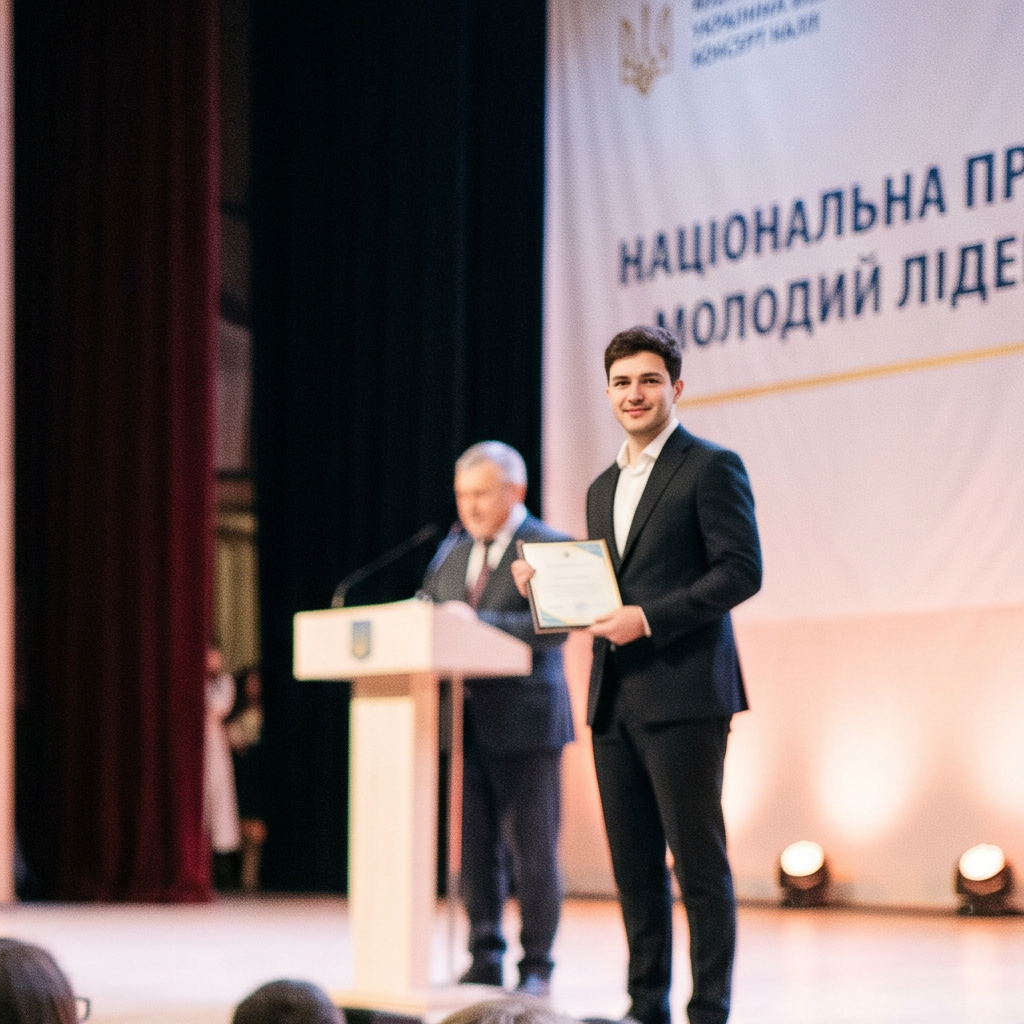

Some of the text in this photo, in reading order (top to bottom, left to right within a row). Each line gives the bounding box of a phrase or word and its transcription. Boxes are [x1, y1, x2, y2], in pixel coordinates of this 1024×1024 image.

[619, 145, 1024, 286] НАЦІОНАЛЬНА ПР
[897, 235, 1017, 308] ЛІДЕ
